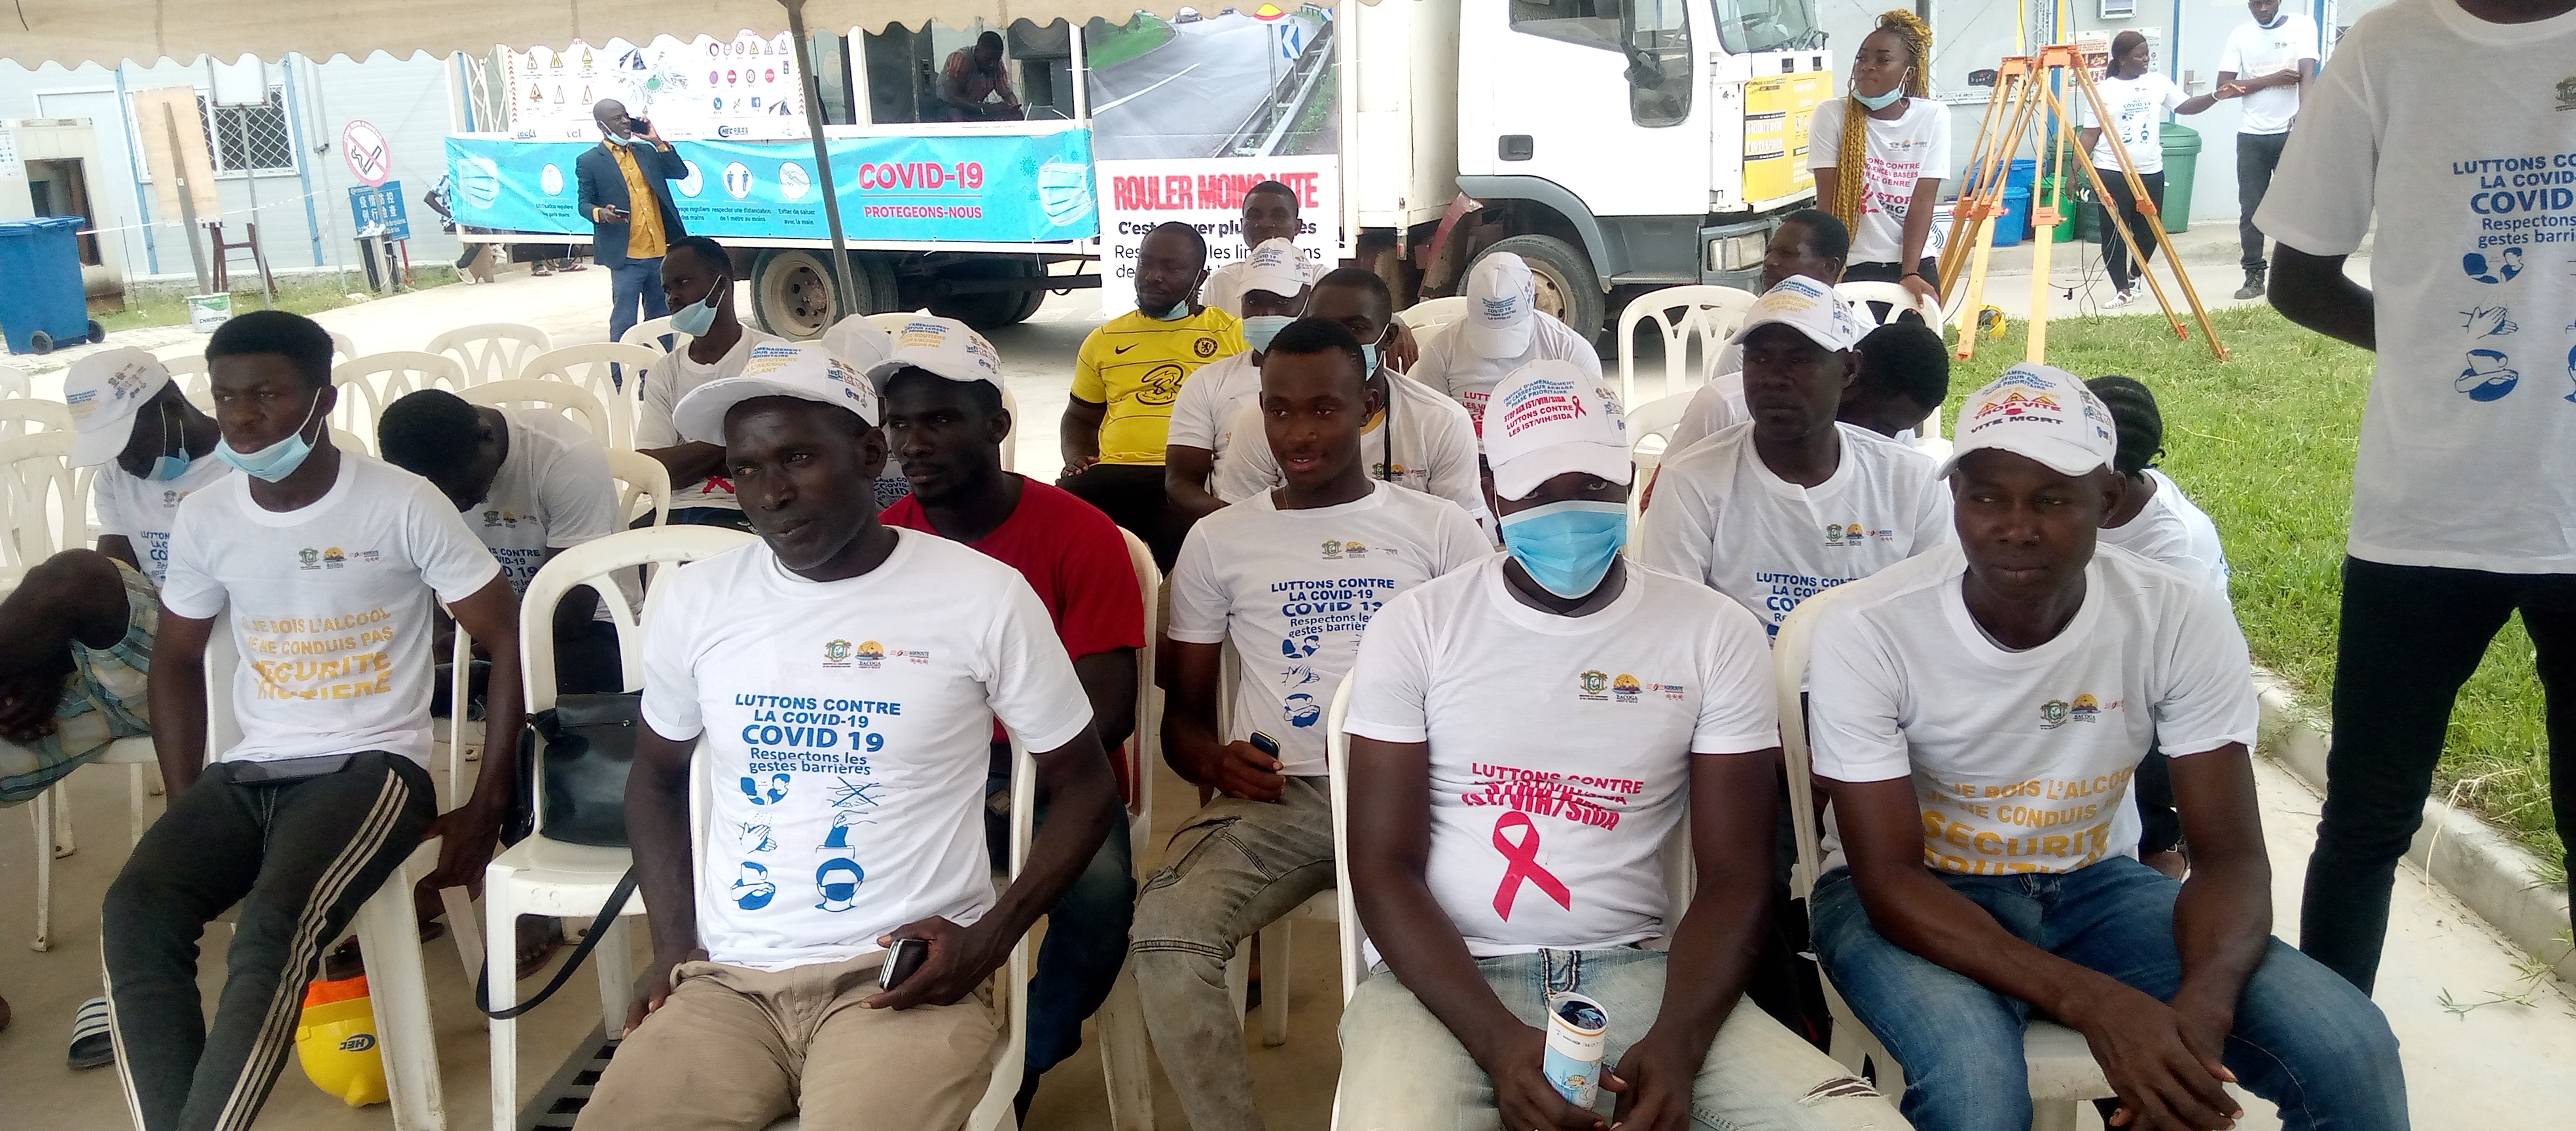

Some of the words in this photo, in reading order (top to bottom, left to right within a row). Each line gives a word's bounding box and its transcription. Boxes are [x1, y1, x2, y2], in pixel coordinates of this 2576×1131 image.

[2453, 156, 2547, 175] LUTTONS
[859, 162, 984, 189] COVID-19
[1882, 177, 1910, 187] GENRE
[2481, 175, 2506, 189] LA
[1114, 175, 1194, 211] ROULER
[1198, 172, 1265, 209] MOIN
[2471, 188, 2573, 215] COVID
[864, 206, 982, 219] PROTEGEONS-NOUS
[1219, 221, 1243, 238] plu
[2482, 215, 2576, 232] Respectons
[2478, 232, 2529, 249] gestes
[2534, 228, 2576, 243] barri
[1210, 244, 1231, 259] les
[1511, 394, 1528, 408] PHASE
[1512, 384, 1546, 401] CARREFOUR
[2022, 402, 2062, 412] VITE
[1507, 410, 1538, 431] LUTTONS
[1539, 404, 1574, 414] CONTRE
[1509, 426, 1521, 438] LES
[1522, 413, 1573, 430] IST/VIH/SIDA
[1970, 418, 2003, 433] VITE
[2009, 416, 2064, 425] MORT
[500, 547, 541, 557] CONTRE
[1271, 579, 1334, 592] LUTTONS
[1338, 578, 1395, 589] CONTRE
[1756, 572, 1817, 586] LUTTONS
[1289, 591, 1307, 601] LA
[1310, 589, 1373, 600] COVID-19
[1772, 585, 1791, 596] LA
[1282, 601, 1352, 617] COVID
[270, 619, 306, 634] BOIS
[310, 607, 391, 634] L'ALCOOL
[1290, 614, 1356, 628] Respectons
[259, 637, 277, 655] NE
[281, 636, 357, 655] CONDUIS
[360, 625, 394, 647] PAS
[1289, 624, 1323, 639] gestes
[735, 694, 817, 710] LUTTONS
[823, 698, 902, 715] CONTRE
[754, 709, 777, 723] LA
[782, 711, 869, 728] COVID-19
[742, 725, 838, 749] COVID
[848, 731, 885, 753] 19
[751, 747, 840, 763] Respectons
[845, 752, 867, 765] les
[749, 761, 797, 774] gestes
[801, 759, 871, 776] barrières
[1472, 762, 1562, 781] LUTTONS
[1985, 780, 2041, 799] BOIS
[1997, 804, 2098, 828] CONDUIS
